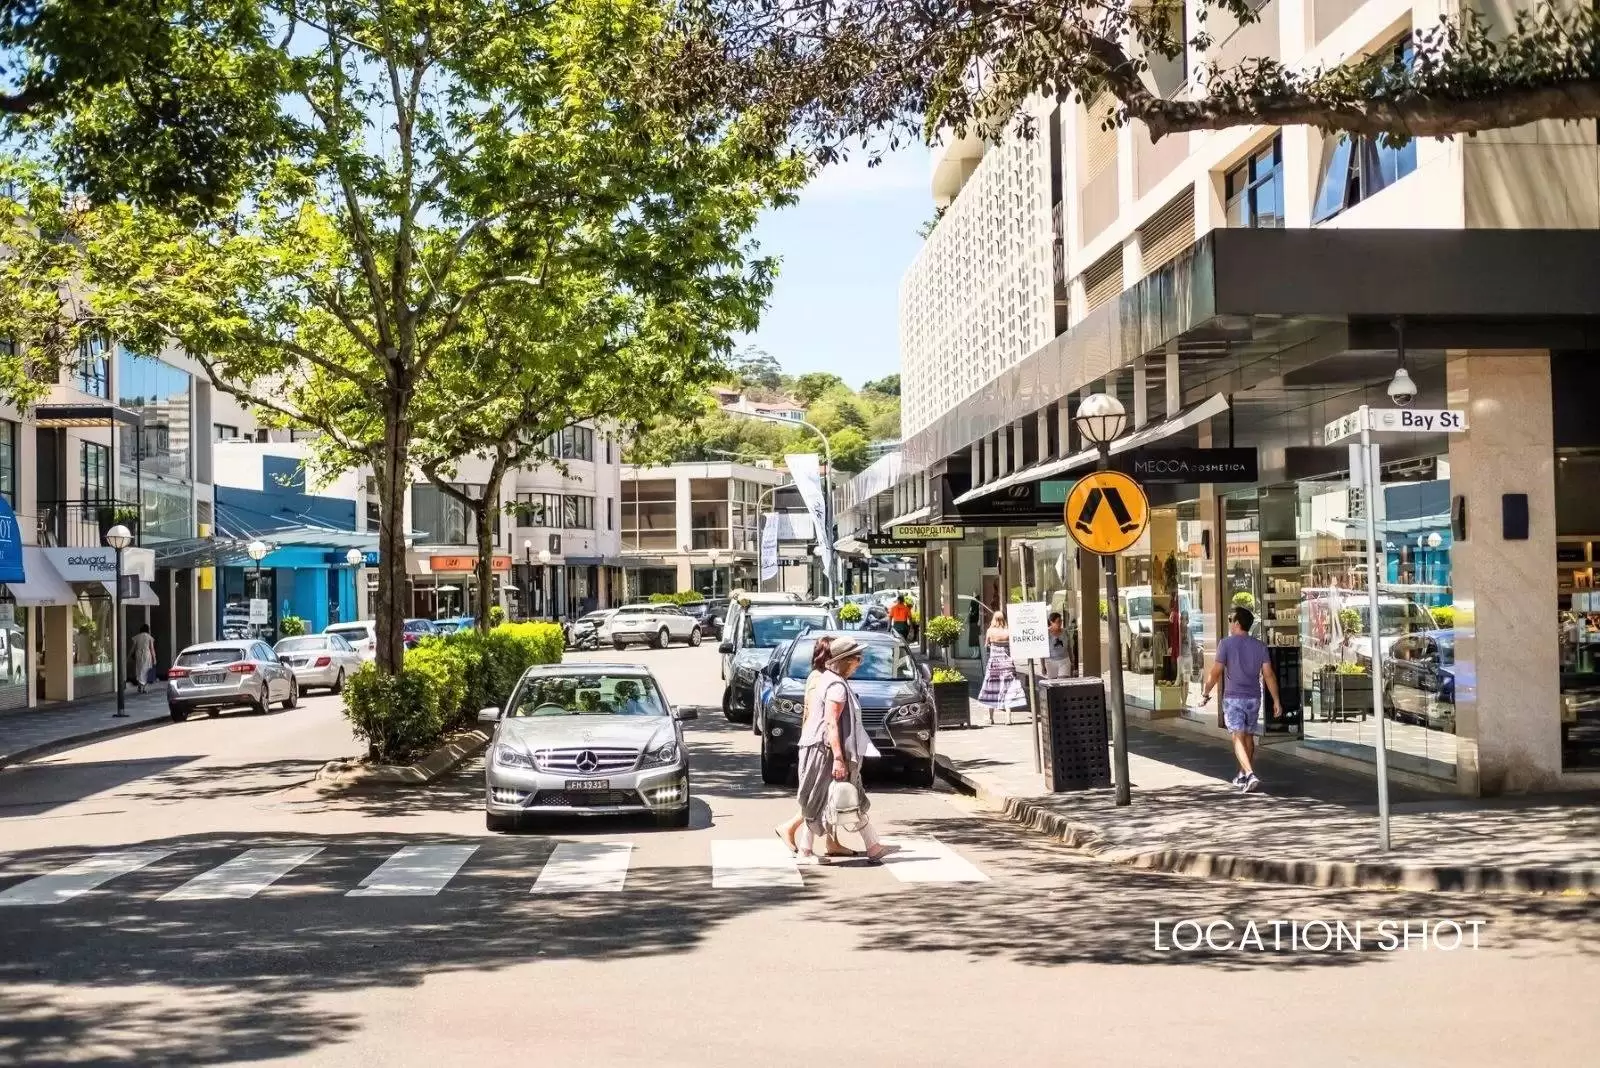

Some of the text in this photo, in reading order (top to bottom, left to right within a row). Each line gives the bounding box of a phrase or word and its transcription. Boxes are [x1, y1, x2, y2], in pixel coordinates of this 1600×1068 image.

[1401, 411, 1459, 430] Bay St
[1135, 460, 1245, 472] MECCA COSMETICA
[899, 526, 956, 534] COSMOPOLITAN
[68, 556, 106, 565] edward
[1022, 628, 1035, 636] NO
[1012, 634, 1045, 643] PARKING
